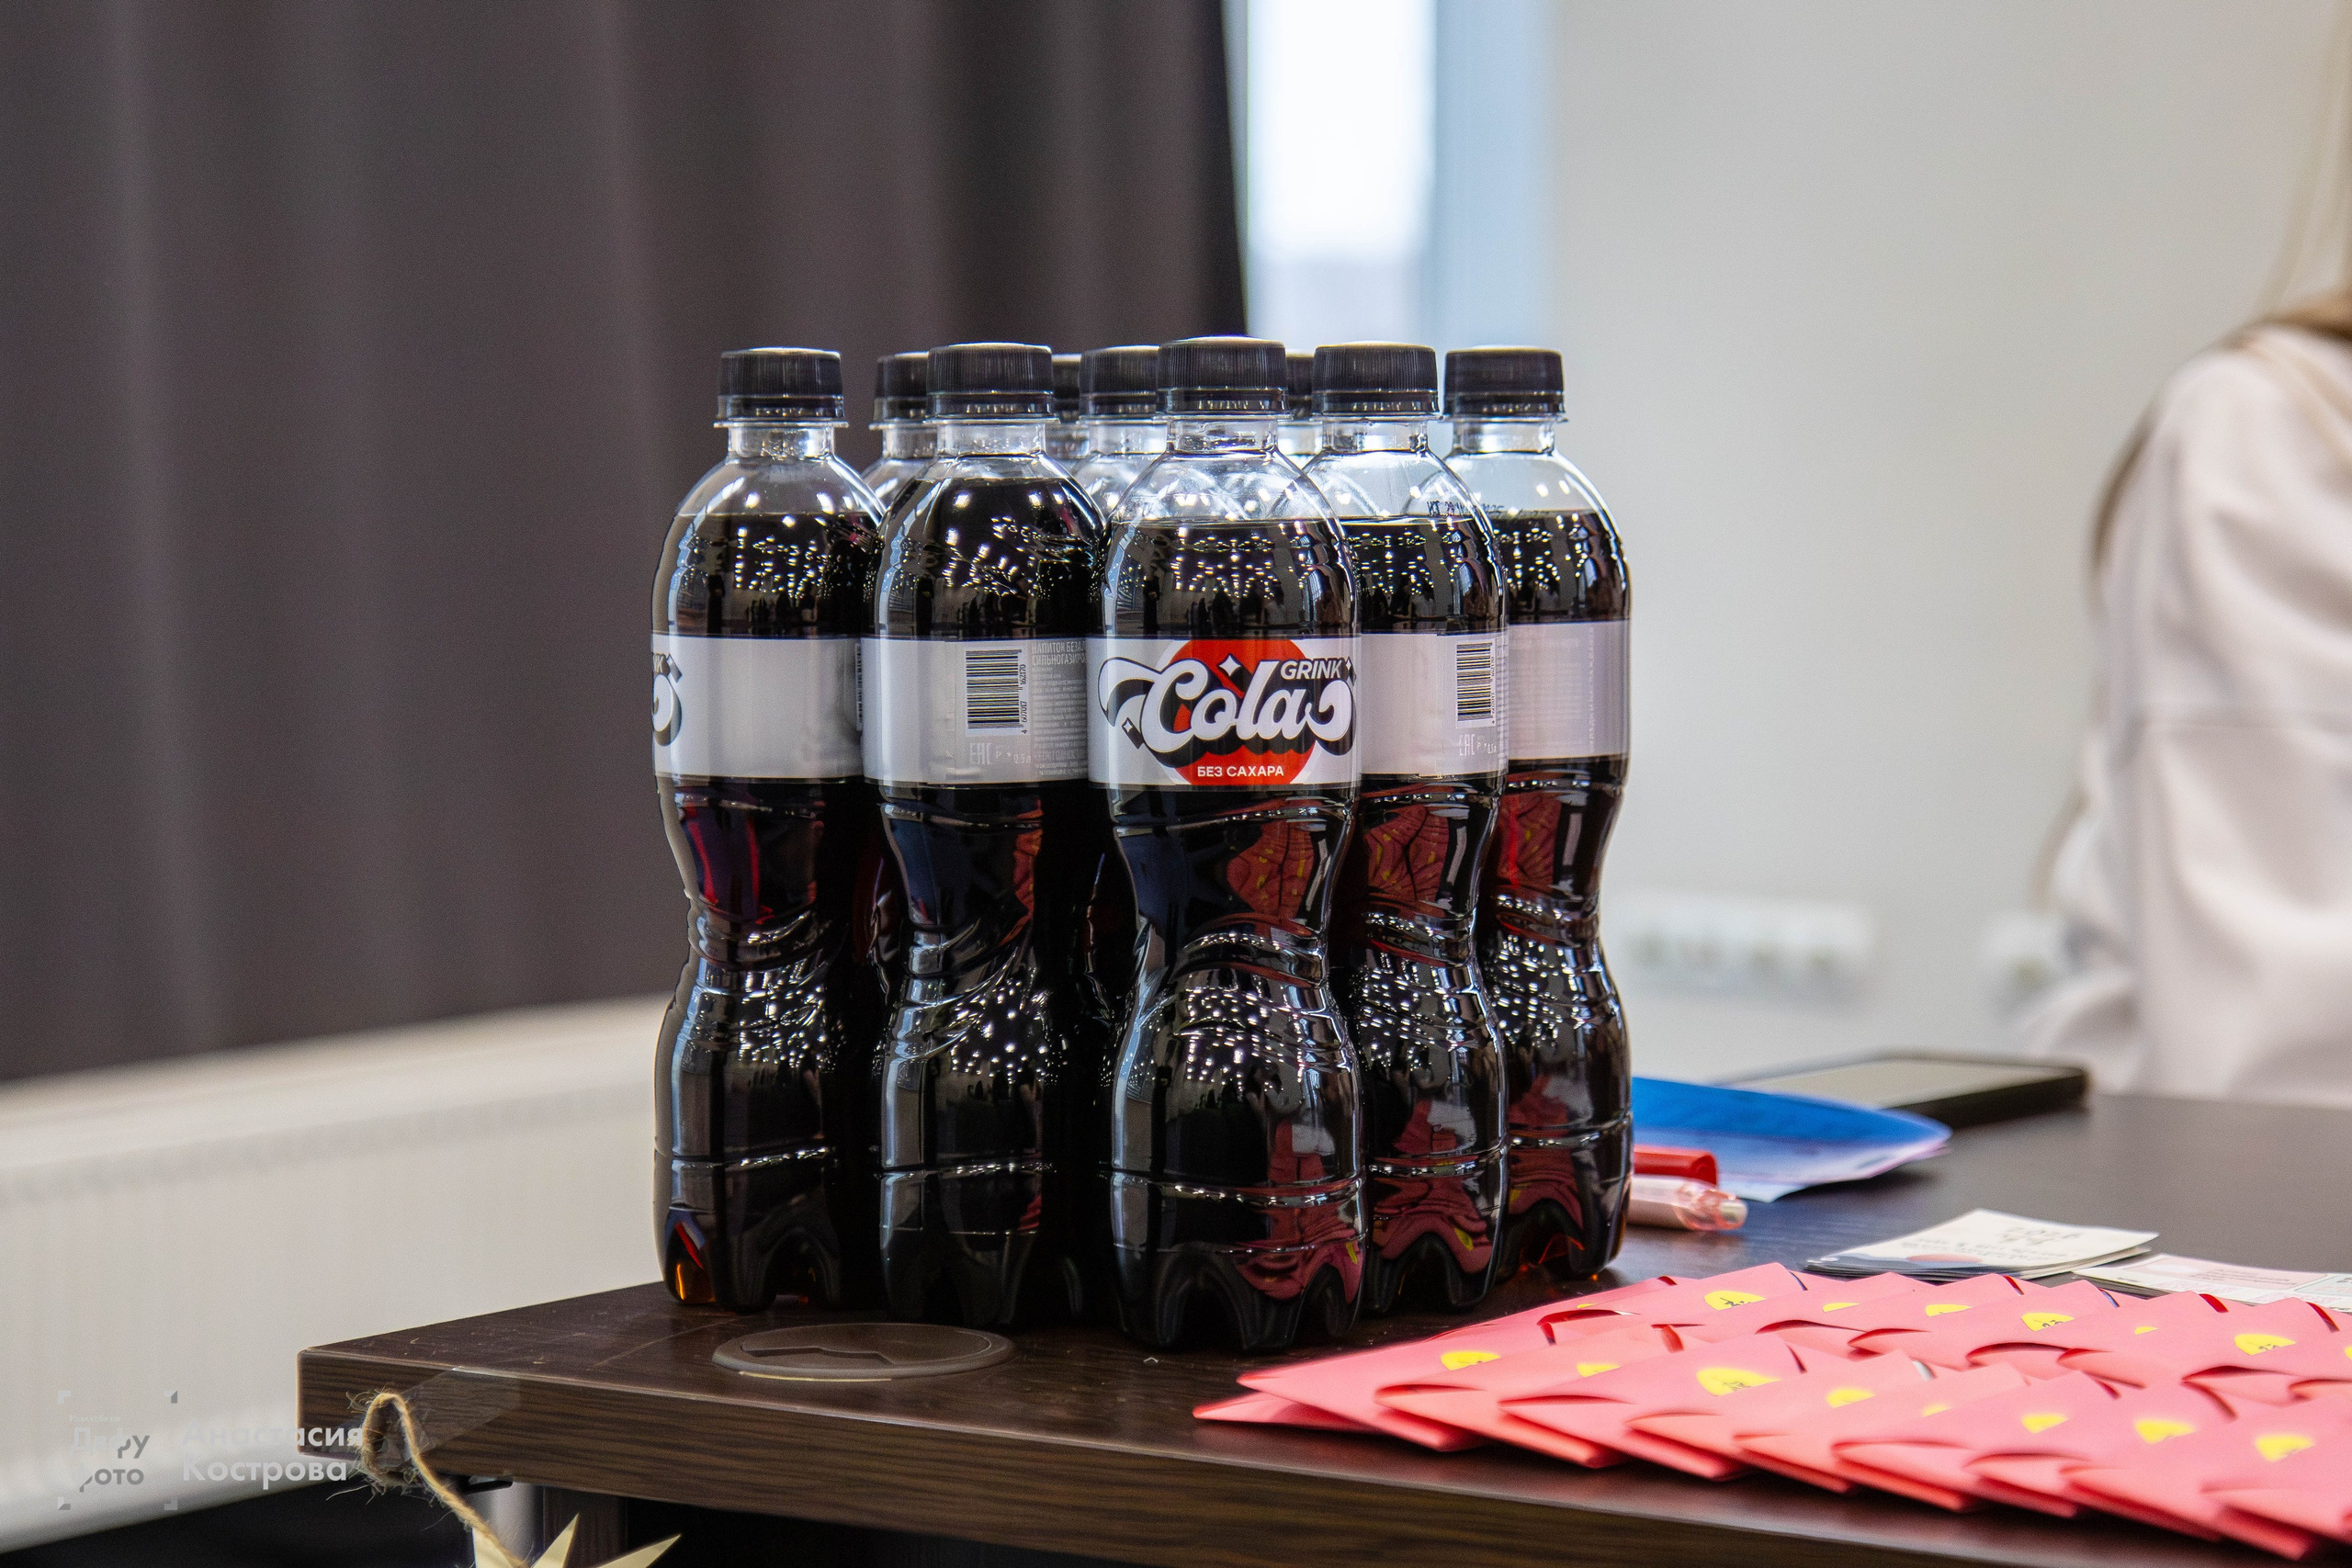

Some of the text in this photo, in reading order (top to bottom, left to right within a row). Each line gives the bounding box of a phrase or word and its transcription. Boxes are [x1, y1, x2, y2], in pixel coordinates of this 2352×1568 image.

[1032, 642, 1065, 654] НАПИТОК
[1280, 659, 1343, 681] GRINK
[1098, 657, 1354, 759] Cola
[1197, 765, 1284, 778] БЕЗ САХАРА
